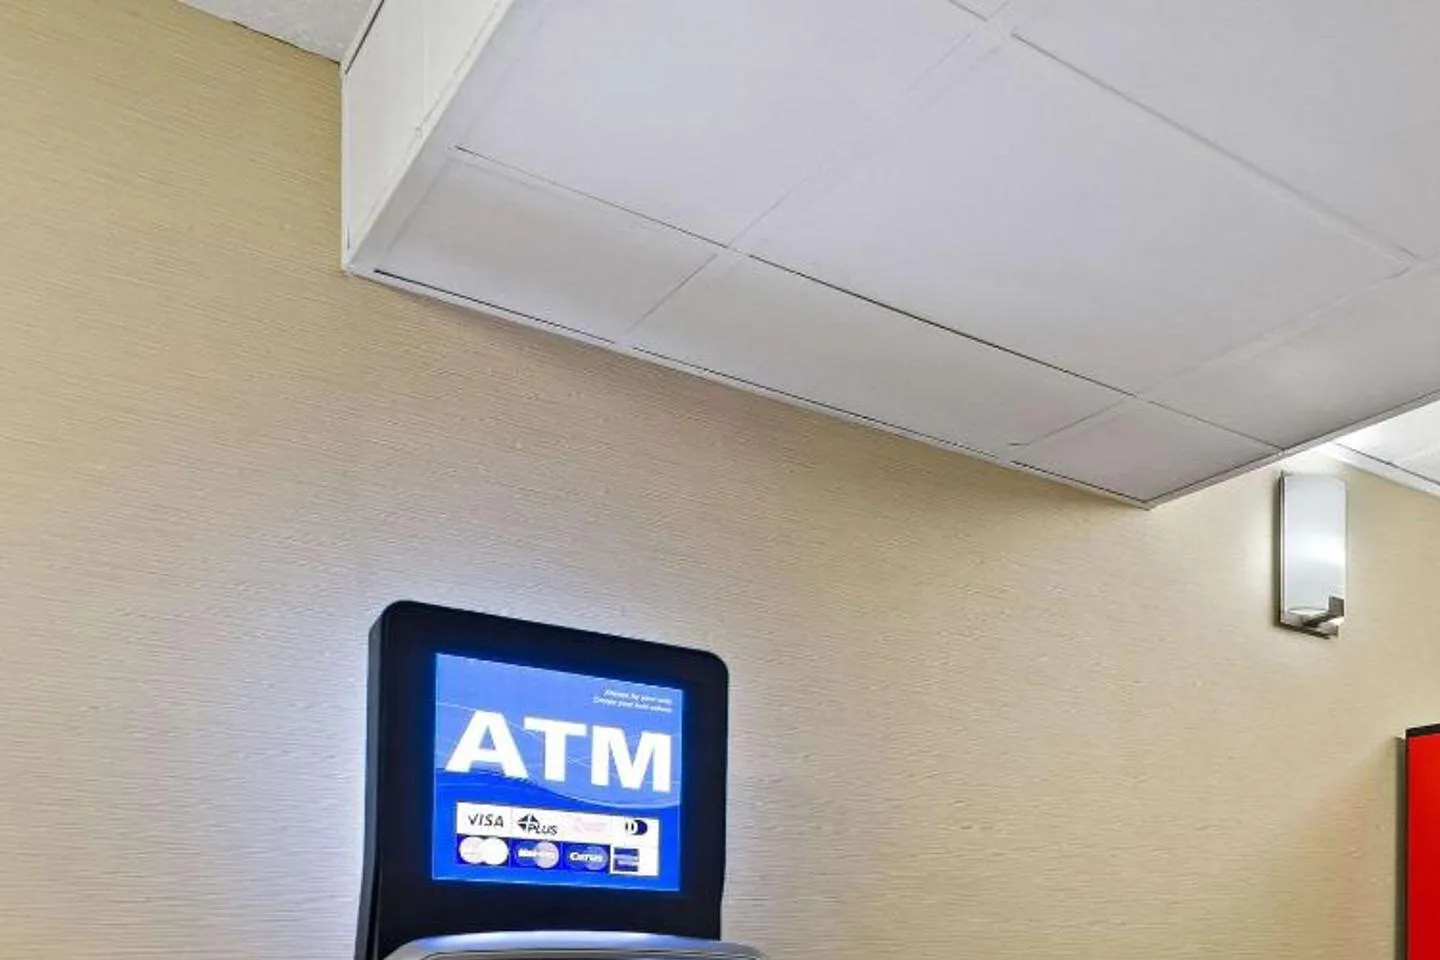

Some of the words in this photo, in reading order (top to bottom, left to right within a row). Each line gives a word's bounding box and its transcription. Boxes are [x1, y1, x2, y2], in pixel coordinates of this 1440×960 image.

[444, 710, 673, 793] ATM
[467, 814, 505, 829] VISA
[527, 821, 558, 835] PLUS
